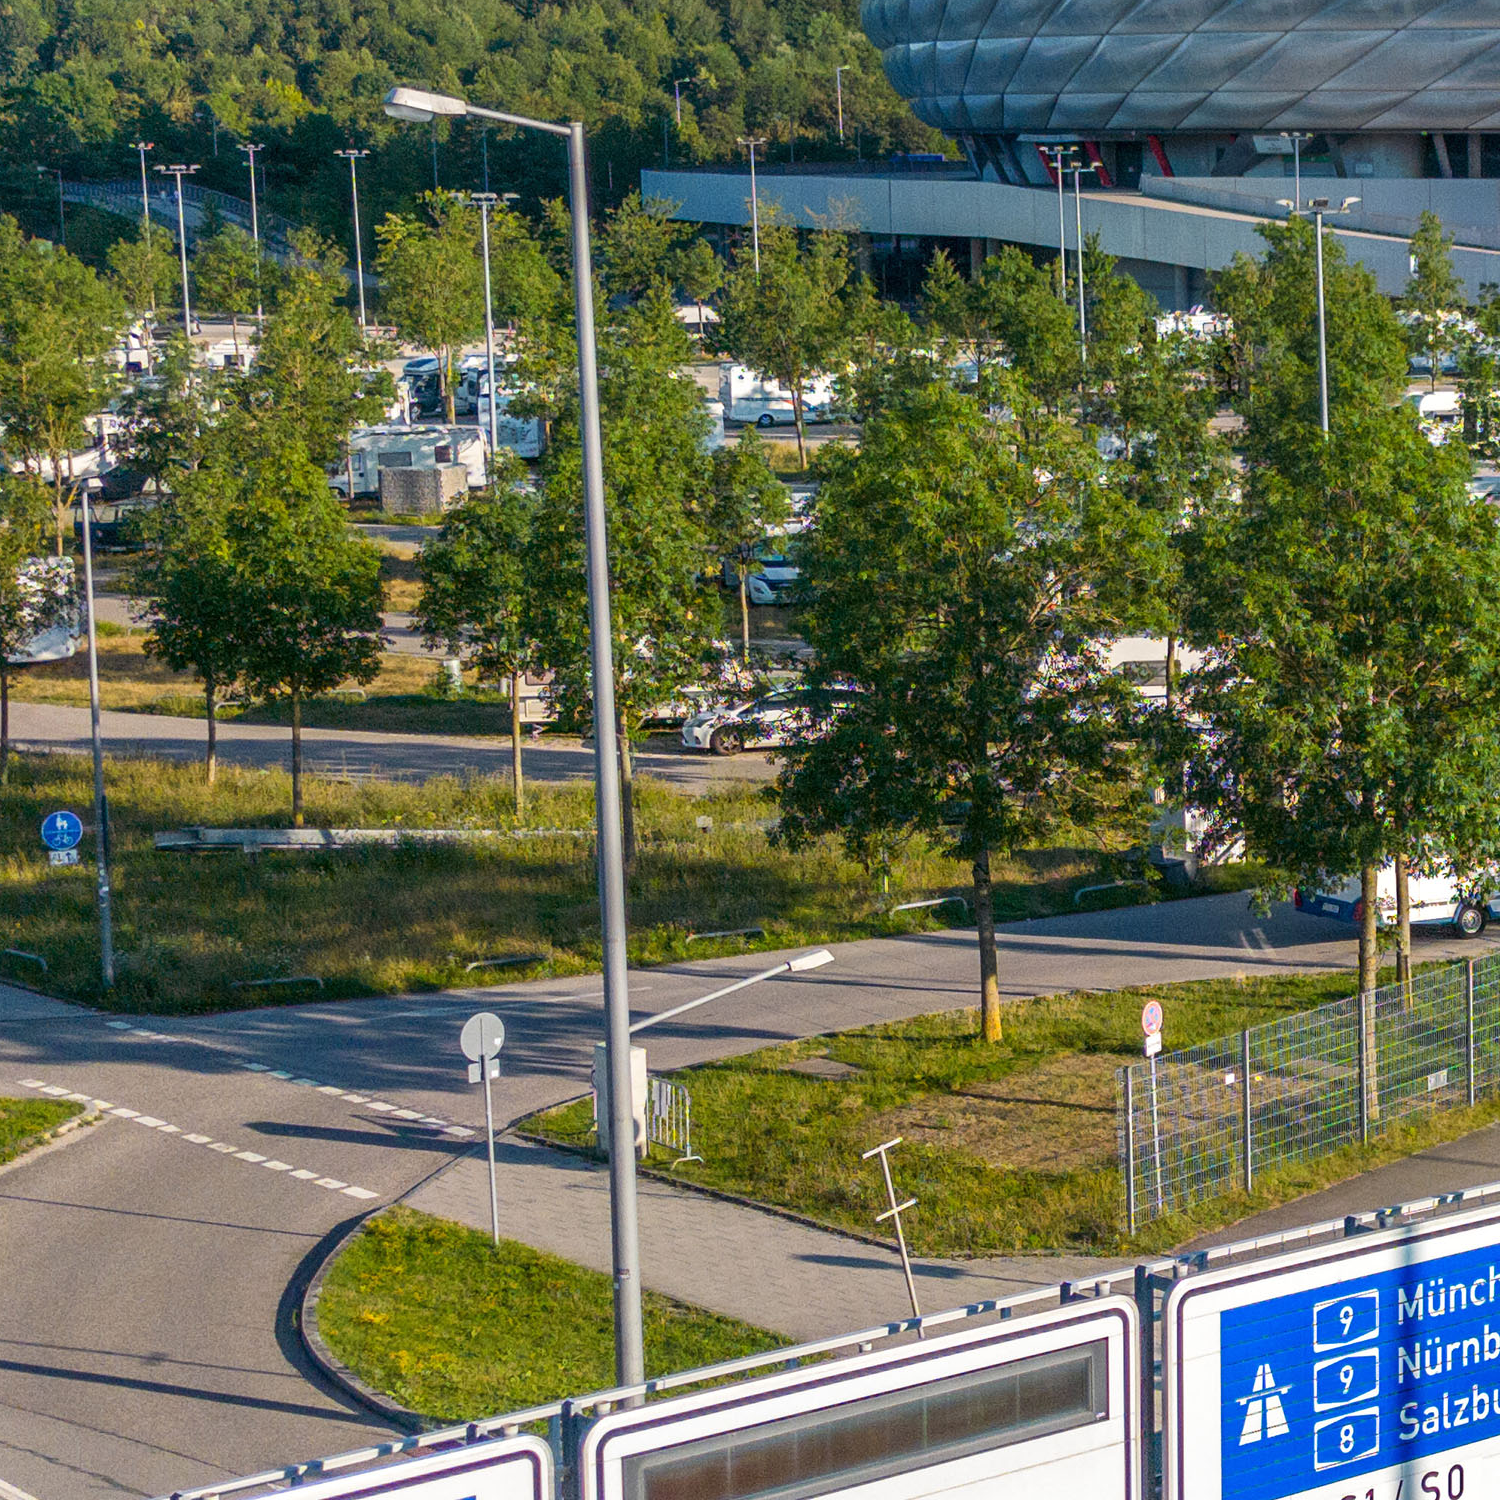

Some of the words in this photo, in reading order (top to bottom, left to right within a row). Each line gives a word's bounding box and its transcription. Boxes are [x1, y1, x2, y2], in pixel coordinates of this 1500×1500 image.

[1339, 1305, 1354, 1337] 9
[1339, 1364, 1354, 1395] 9
[1338, 1424, 1354, 1455] 8
